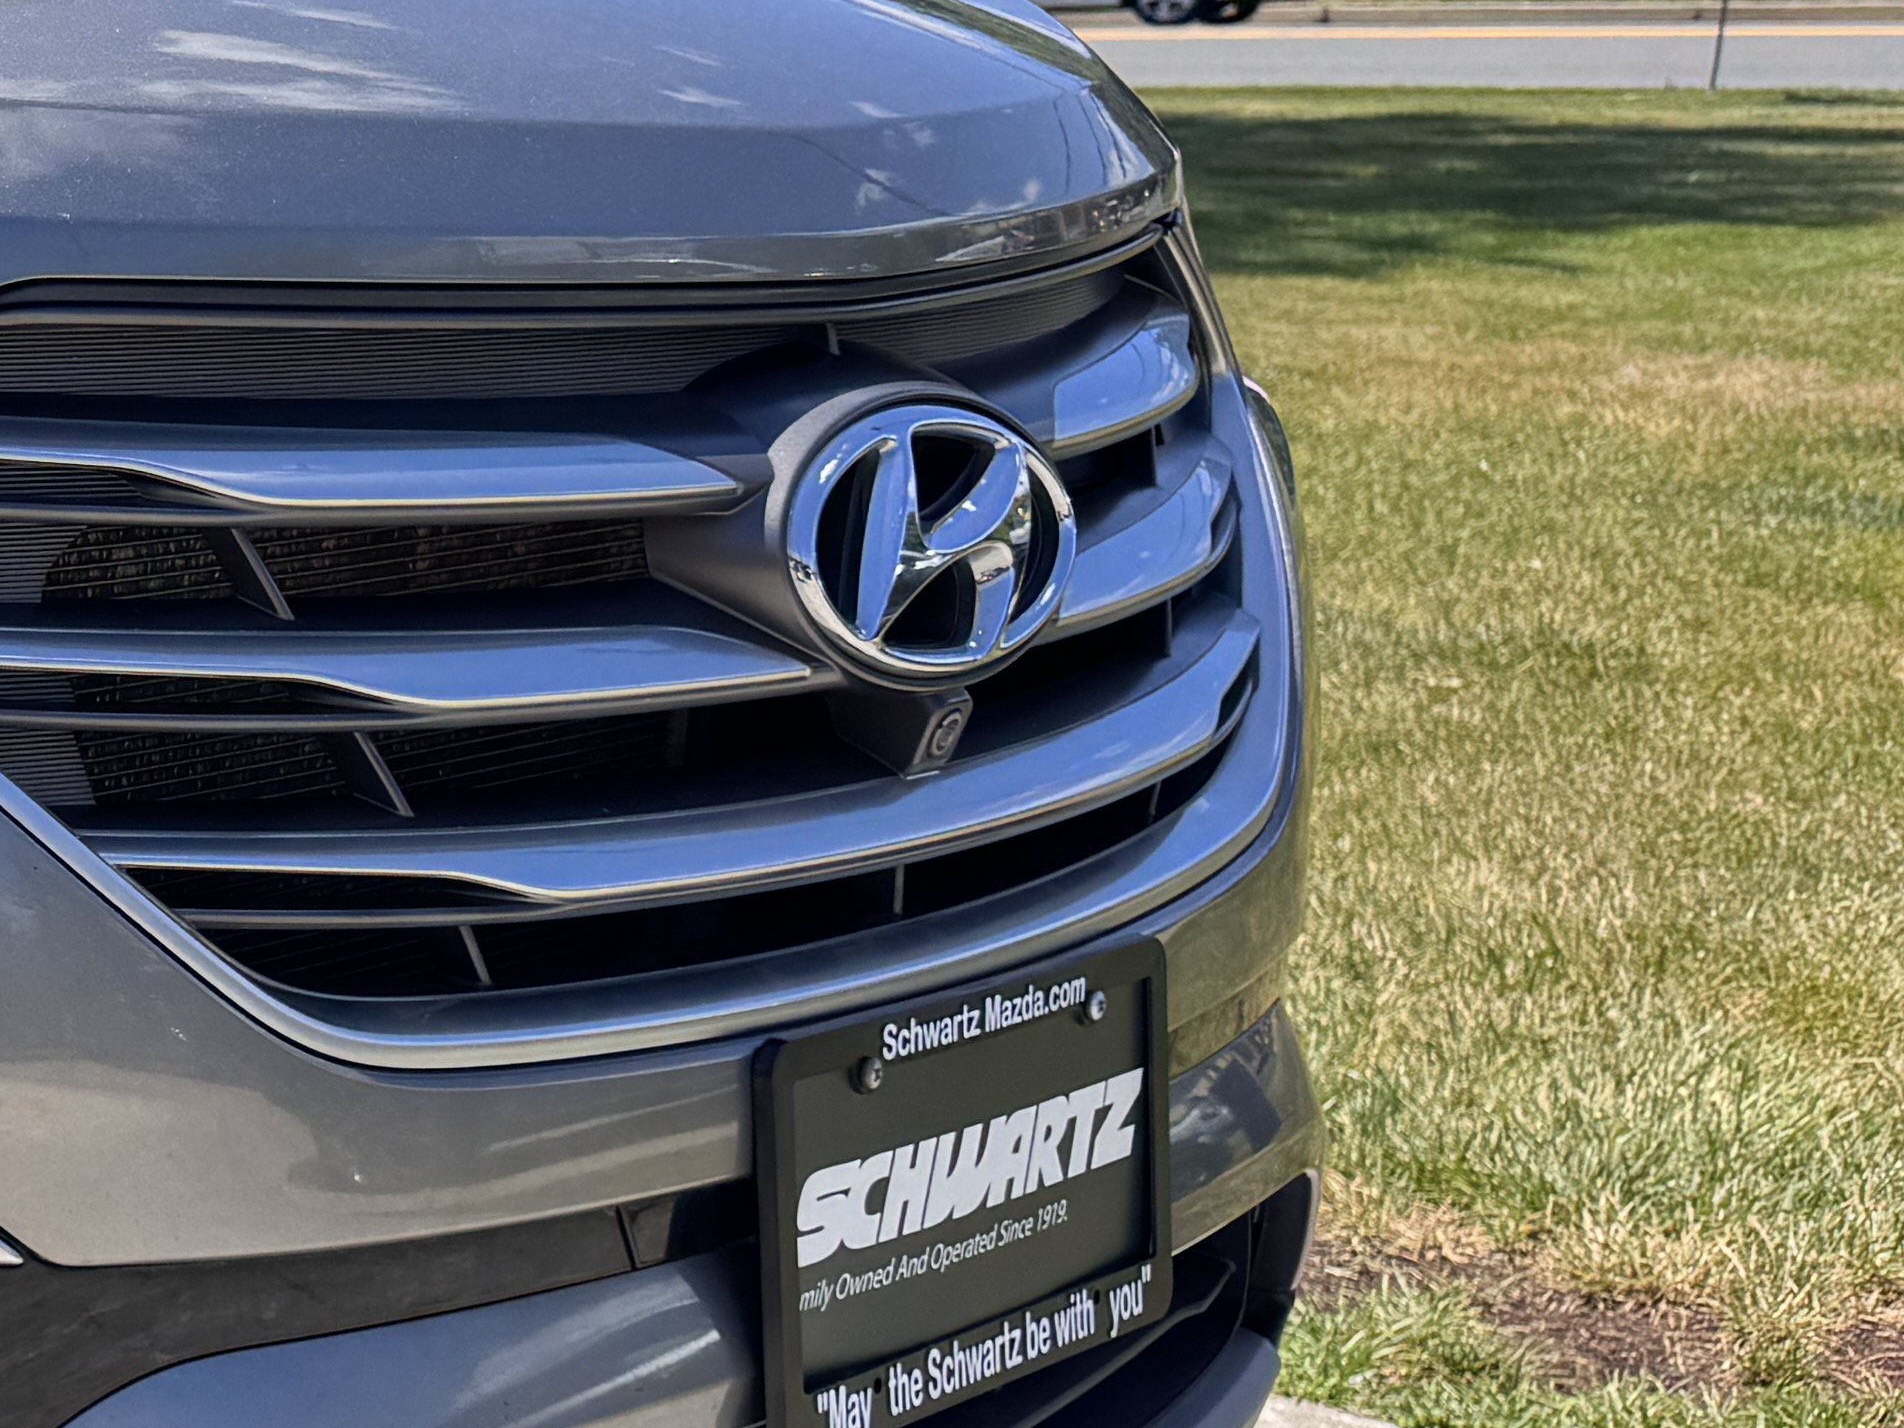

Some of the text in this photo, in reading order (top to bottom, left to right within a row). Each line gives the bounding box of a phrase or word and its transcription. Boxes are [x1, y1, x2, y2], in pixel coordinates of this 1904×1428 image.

[882, 976, 1086, 1061] Schwartz Mazda.com
[796, 1066, 1144, 1268] SCHWARTZ
[835, 1255, 894, 1300] Owned
[895, 1248, 930, 1281] And
[931, 1223, 998, 1273] Operated
[998, 1215, 1033, 1247] Since
[888, 1362, 924, 1416] the
[928, 1320, 1023, 1400] Schwartz
[1025, 1311, 1051, 1359] be
[1054, 1288, 1095, 1348] with
[1109, 1264, 1152, 1338] you"
